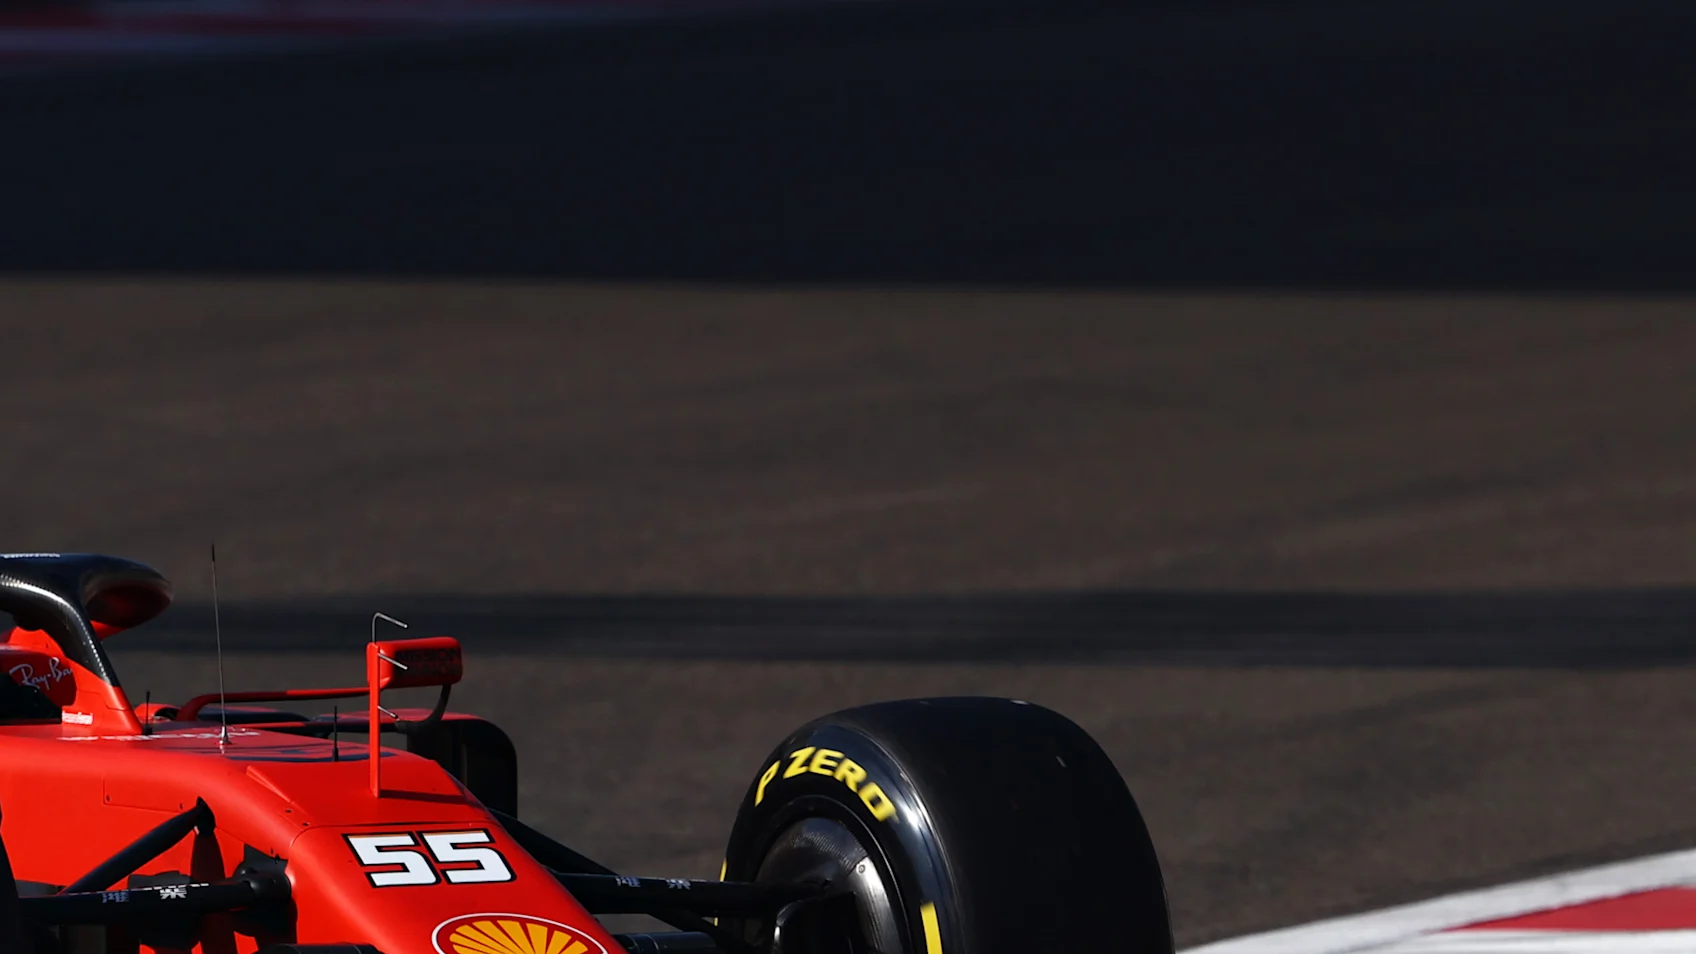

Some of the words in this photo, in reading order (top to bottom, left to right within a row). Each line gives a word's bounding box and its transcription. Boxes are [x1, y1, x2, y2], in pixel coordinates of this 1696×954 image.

[8, 656, 73, 691] Ray-Ba
[754, 760, 781, 808] P
[782, 746, 897, 822] ZERO
[345, 830, 516, 888] 55
